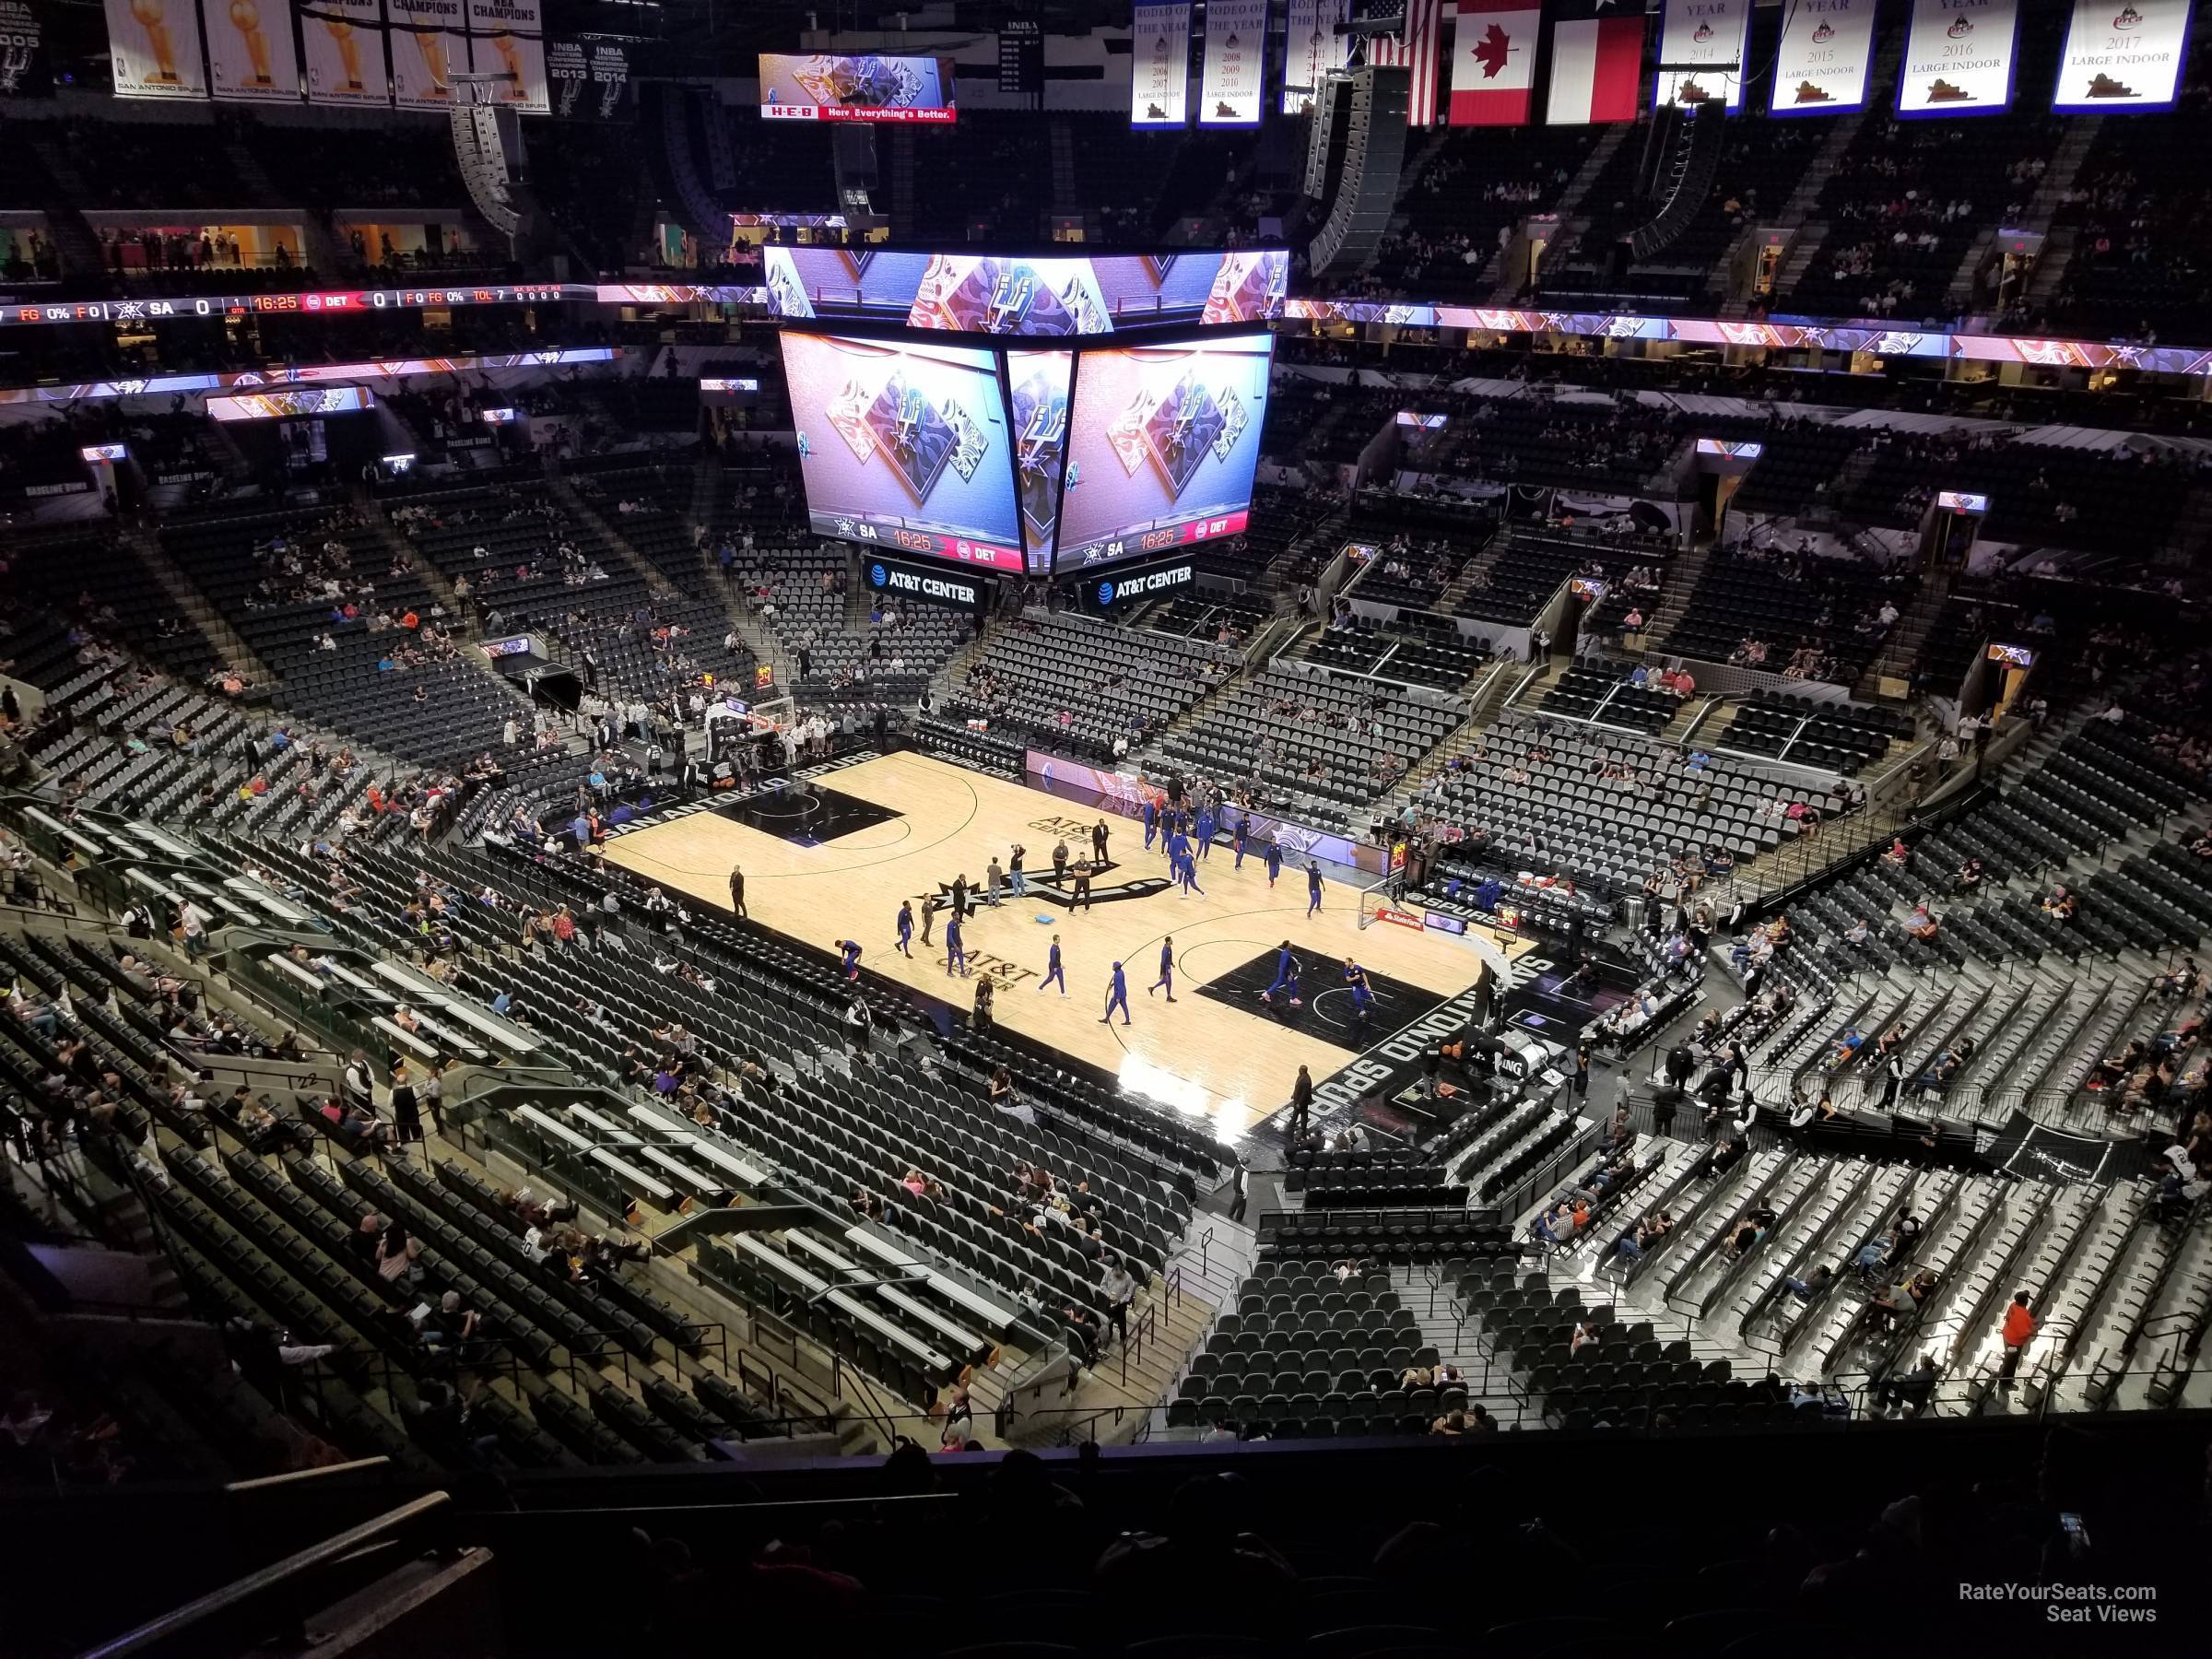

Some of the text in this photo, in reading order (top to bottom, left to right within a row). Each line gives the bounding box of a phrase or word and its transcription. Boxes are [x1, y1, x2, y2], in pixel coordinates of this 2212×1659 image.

[393, 0, 458, 15] CHAMPIONS
[1136, 6, 1189, 18] RODEO OF
[1209, 4, 1265, 16] RODEO OF
[1687, 3, 1725, 16] YEAR
[1806, 0, 1850, 13] YEAR
[473, 6, 535, 21] CHAMPIONS
[1209, 19, 1263, 30] THE YEAR
[1290, 16, 1314, 25] THE
[1137, 22, 1187, 34] THE YEAR
[558, 43, 582, 52] NBA
[1942, 43, 1974, 57] 2016
[2106, 37, 2142, 50] 2017
[600, 47, 624, 56] NBA
[1222, 53, 1241, 62] 2008
[1689, 48, 1714, 60] 2014
[1807, 50, 1834, 63] 2015
[2072, 52, 2170, 65] LARGE INDOOR
[1221, 65, 1241, 75] 2009
[1785, 65, 1855, 79] LARGE INDOOR
[1912, 58, 2001, 74] LARGE INDOOR
[552, 68, 587, 79] 2013
[594, 71, 627, 83] 2014
[1221, 77, 1239, 88] 2010
[771, 106, 812, 117] H-E-B
[829, 108, 950, 119] Here Everything's Better.
[233, 298, 240, 307] 1
[325, 296, 347, 307] DET
[372, 292, 386, 307] 0
[406, 289, 504, 303] F 0 FG 0% TOL 7
[516, 292, 523, 300] 0
[149, 302, 174, 315] SA
[195, 300, 210, 314] 0
[254, 296, 297, 310] 16:25
[20, 306, 100, 320] FG 0% F 0
[2011, 426, 2025, 434] 109
[159, 472, 193, 485] BASELINE
[25, 484, 64, 496] BASELINE
[859, 524, 878, 539] SA
[1209, 519, 1228, 534] DET
[893, 530, 931, 551] 16:25
[1140, 529, 1174, 550] 16:25
[974, 547, 996, 562] DET
[1107, 541, 1124, 557] SA
[888, 571, 975, 604] AT&T CENTER
[1115, 566, 1192, 599] AT&T CENTER
[759, 673, 771, 685] 24
[791, 749, 883, 781] SPURS
[930, 750, 1018, 780] SPURS.COM
[605, 811, 665, 841] SAN
[1045, 817, 1113, 835] AT&
[1392, 852, 1405, 868] 24
[961, 949, 1042, 982] AT&T
[1379, 990, 1477, 1062] NTONIO
[298, 1072, 317, 1089] 22
